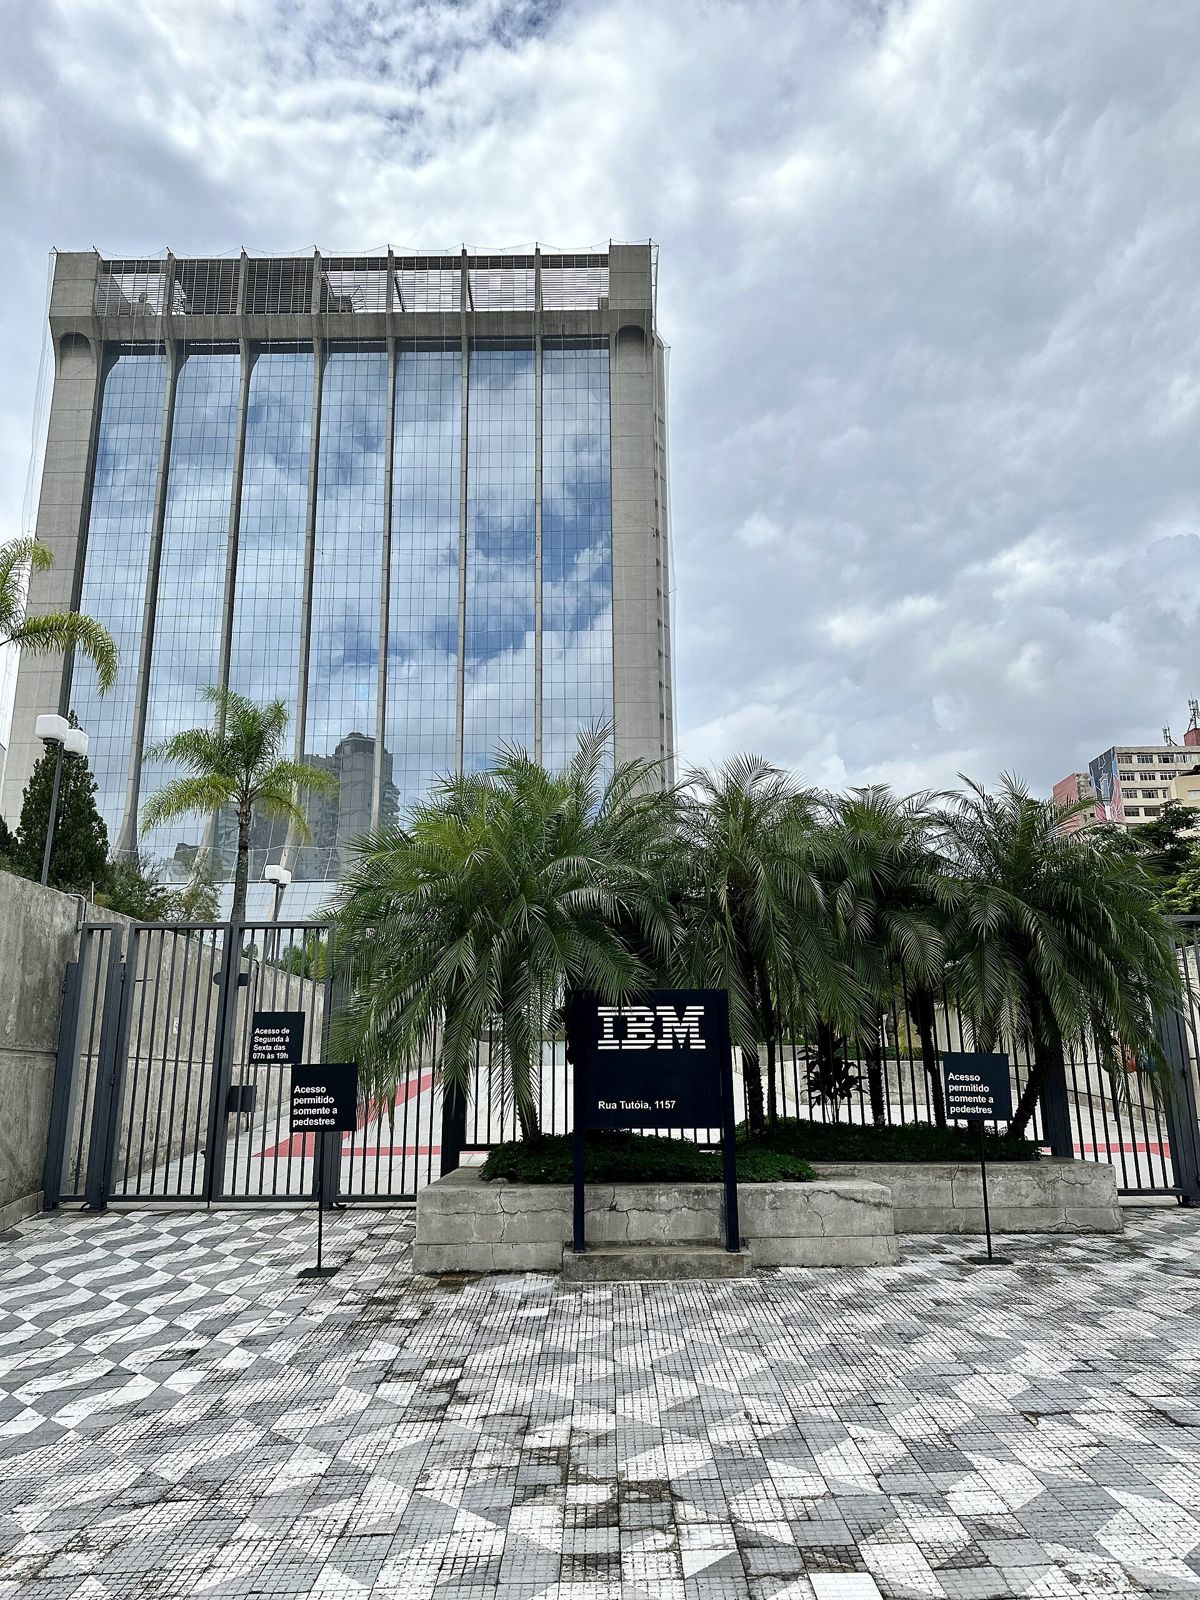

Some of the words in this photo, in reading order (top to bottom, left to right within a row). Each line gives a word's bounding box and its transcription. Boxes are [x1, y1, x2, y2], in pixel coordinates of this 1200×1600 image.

[597, 1005, 706, 1050] IBM
[948, 1072, 981, 1081] Acesso
[294, 1086, 326, 1094] Acesso
[948, 1084, 990, 1093] permitido
[293, 1095, 335, 1106] permitido
[949, 1095, 987, 1103] somente
[988, 1096, 994, 1104] a
[597, 1101, 617, 1110] Rua
[620, 1101, 652, 1111] Tutóia,
[655, 1101, 676, 1109] 1157
[950, 1105, 993, 1114] pedestres
[293, 1107, 330, 1115] somente
[293, 1117, 335, 1127] pedestres
